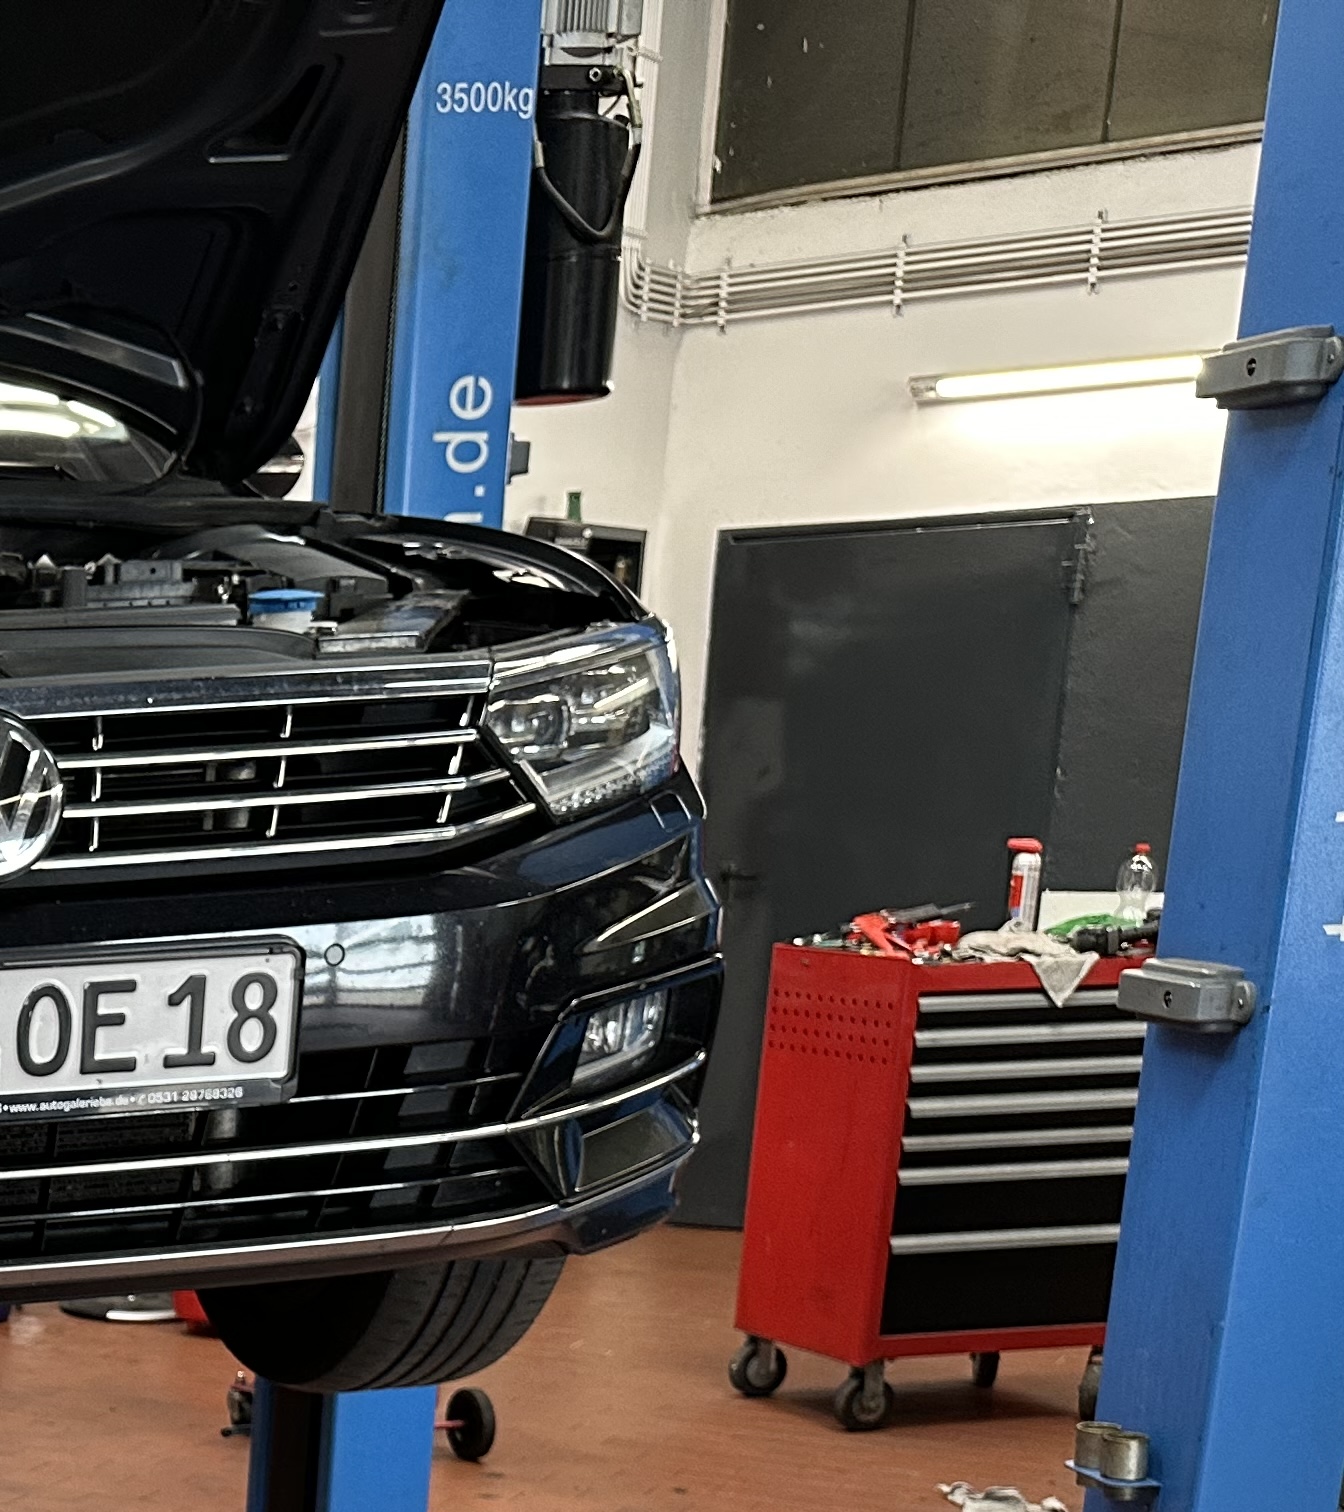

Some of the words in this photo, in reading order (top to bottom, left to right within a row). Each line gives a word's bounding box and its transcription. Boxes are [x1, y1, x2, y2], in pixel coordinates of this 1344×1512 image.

[435, 80, 534, 120] 3500kg
[15, 978, 139, 1077] OE
[162, 971, 279, 1069] 18
